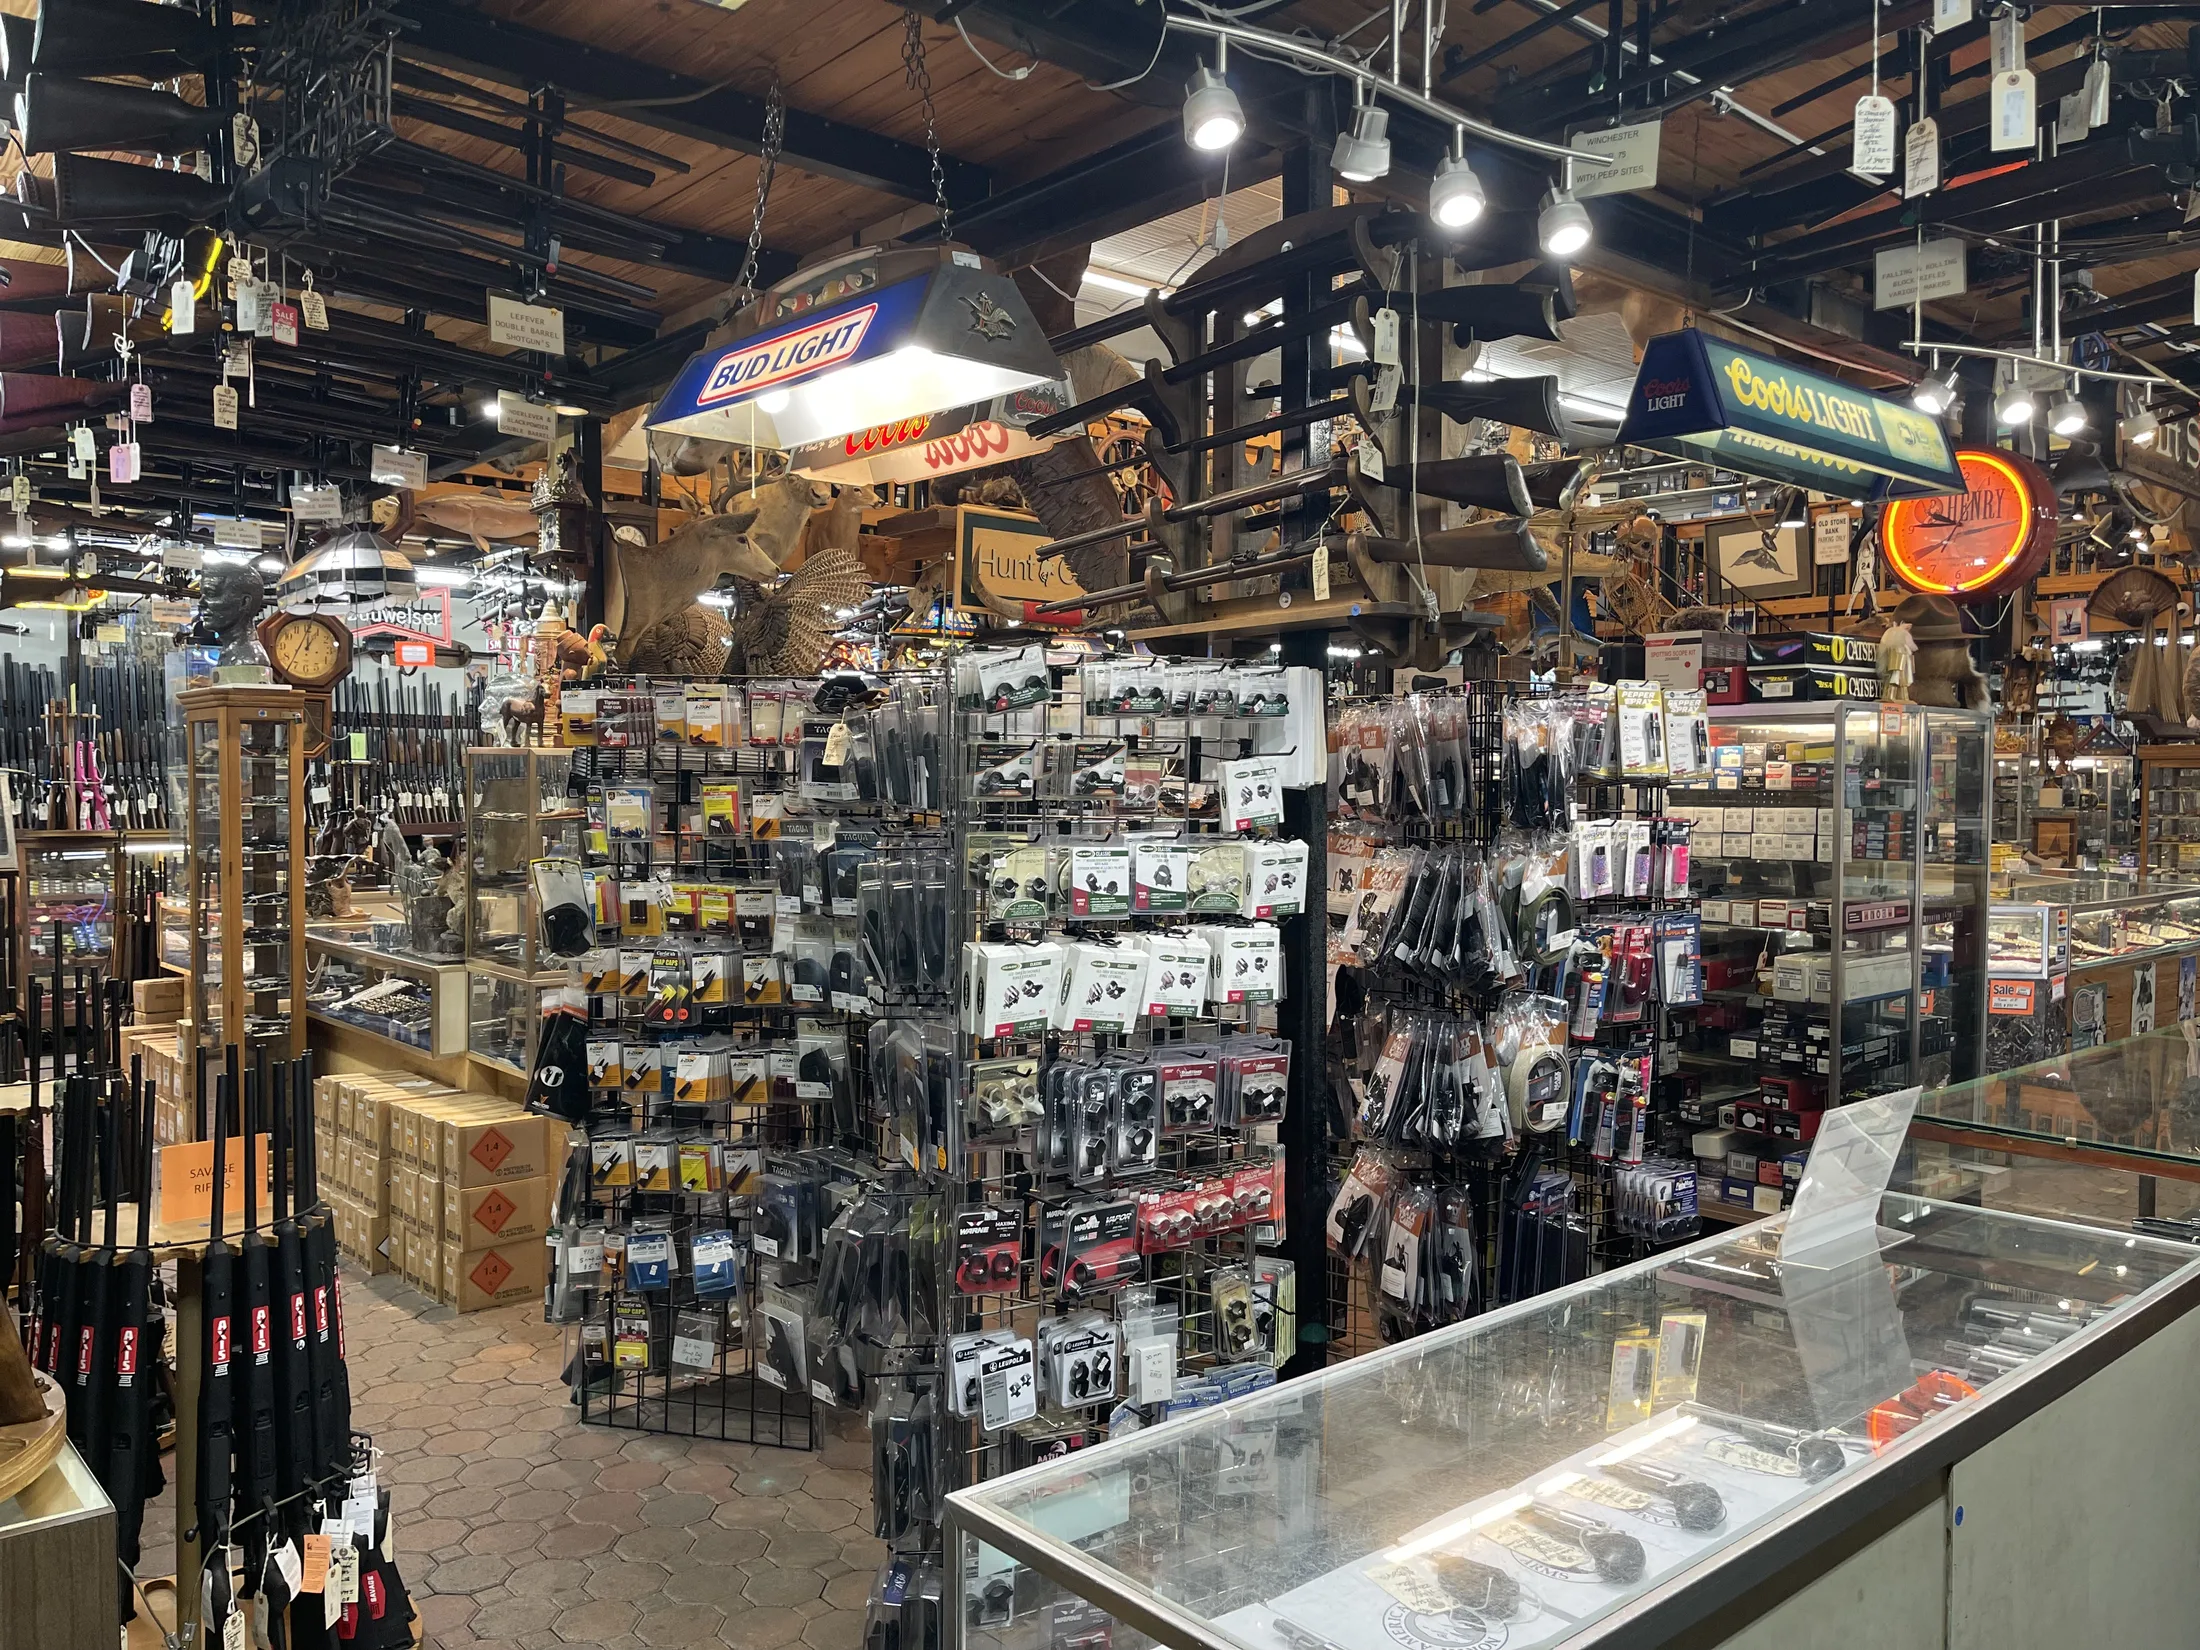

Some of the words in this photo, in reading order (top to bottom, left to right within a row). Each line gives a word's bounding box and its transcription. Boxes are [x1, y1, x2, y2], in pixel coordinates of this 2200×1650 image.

[1586, 130, 1639, 146] WINCHESTER
[1618, 151, 1626, 159] 75
[1576, 173, 1596, 183] WITH
[1597, 169, 1619, 180] PEEP
[1620, 165, 1644, 176] SITES
[1882, 267, 1913, 280] FALLING
[1926, 257, 1957, 270] ROLLING
[1892, 277, 1915, 288] BLOCK
[1919, 270, 1946, 282] RIFLES
[1923, 279, 1951, 291] MAKERS
[275, 308, 294, 321] SALE
[510, 312, 545, 325] LEFEVER
[495, 320, 525, 332] DOUBLE
[530, 327, 559, 340] BARREL
[711, 352, 773, 391] BUD
[774, 319, 863, 371] LIGHT
[1643, 377, 1692, 398] Coors
[1647, 393, 1687, 412] LIGHT
[1724, 356, 1812, 423] Coors
[1804, 387, 1878, 442] LIGHT
[506, 408, 544, 421] NDERLEVER
[500, 425, 525, 435] DOUBLE
[507, 417, 549, 430] BLACKPOWDER
[1947, 487, 2006, 523] HENRY
[1818, 520, 1828, 528] OLD
[1830, 517, 1846, 526] STONE
[1825, 527, 1839, 535] BANK
[1817, 535, 1835, 544] PARKING
[1836, 534, 1846, 542] ONLY
[979, 547, 1035, 582] Hunt
[1861, 562, 1870, 570] 24
[1650, 651, 1671, 659] SPOTTING
[1671, 650, 1686, 658] SCOPE
[1687, 649, 1696, 657] KIT
[1812, 642, 1831, 653] BSA
[1846, 640, 1879, 662] CATSEY
[1815, 679, 1834, 690] BSA
[1622, 690, 1656, 699] PEPPER
[1624, 697, 1654, 705] SPRAY
[1667, 699, 1702, 708] PEPPER
[1670, 705, 1700, 713] SPRAY
[786, 824, 809, 833] TAGUA
[842, 832, 869, 841] TAGUA
[652, 958, 665, 967] SNAP
[665, 959, 678, 967] CAPS
[1993, 983, 2014, 996] Sale
[485, 1142, 499, 1152] 1.4
[190, 1162, 235, 1179] SAVGE
[771, 1164, 793, 1177] TAGUA
[194, 1180, 231, 1194] RIFS
[487, 1203, 501, 1214] 1.4
[1105, 1212, 1132, 1223] VAPOR
[959, 1226, 990, 1235] WARNE
[483, 1266, 498, 1276] 1.4
[318, 1287, 328, 1329] AXIS
[617, 1307, 631, 1315] SNAP
[632, 1308, 646, 1316] CAPS
[295, 1296, 305, 1337] AXIS
[256, 1309, 267, 1350] AXIS
[51, 1325, 59, 1368] AXIS
[216, 1319, 227, 1361] AXIS
[1072, 1340, 1091, 1348] LEUPOLD
[80, 1329, 90, 1371] AXIS
[122, 1330, 134, 1372] AXIS
[998, 1356, 1024, 1369] LEUPOLD
[1230, 1385, 1251, 1394] Utility
[1168, 1397, 1192, 1406] Utility
[1522, 1557, 1571, 1582] ARMS
[367, 1575, 377, 1603] SAVAGE
